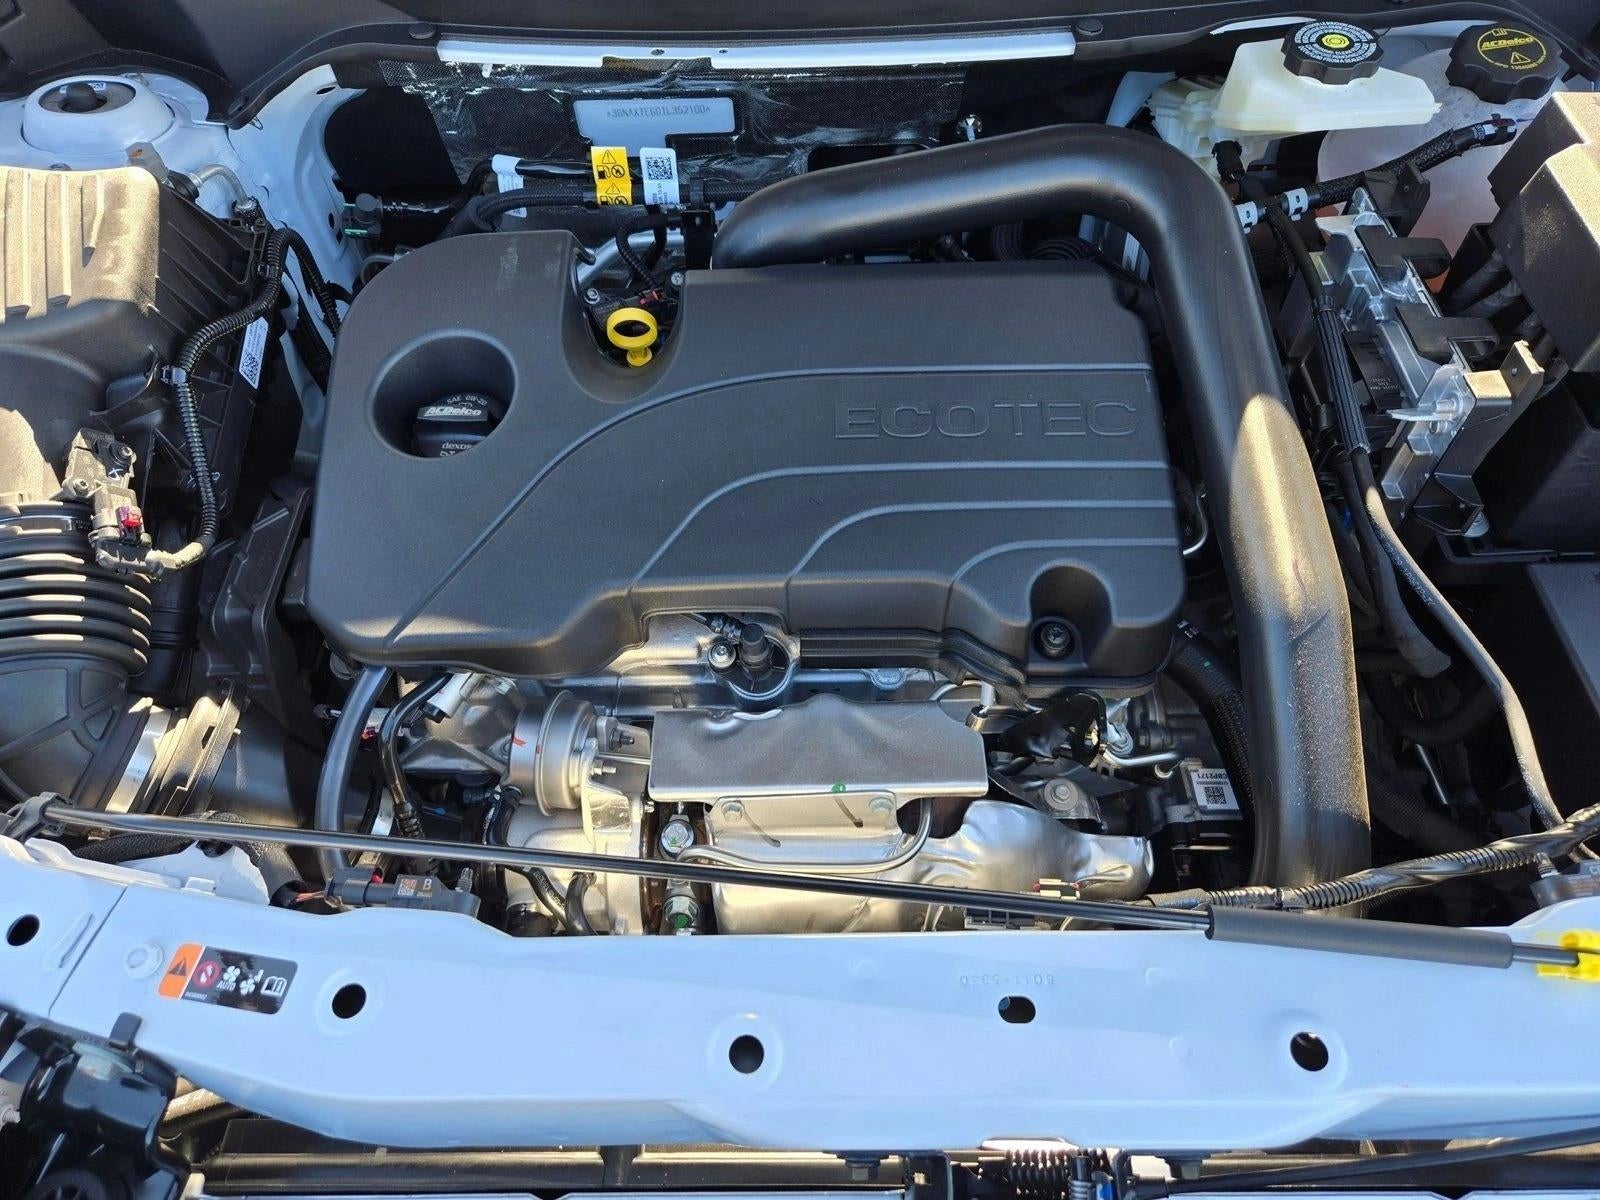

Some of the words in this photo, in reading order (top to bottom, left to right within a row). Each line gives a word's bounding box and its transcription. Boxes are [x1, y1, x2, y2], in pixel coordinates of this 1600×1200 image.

[1481, 37, 1534, 50] ACDelco
[447, 396, 461, 404] SAE
[424, 406, 482, 417] ACDelco
[835, 400, 1136, 439] ECOTEC
[217, 980, 236, 992] AUTO
